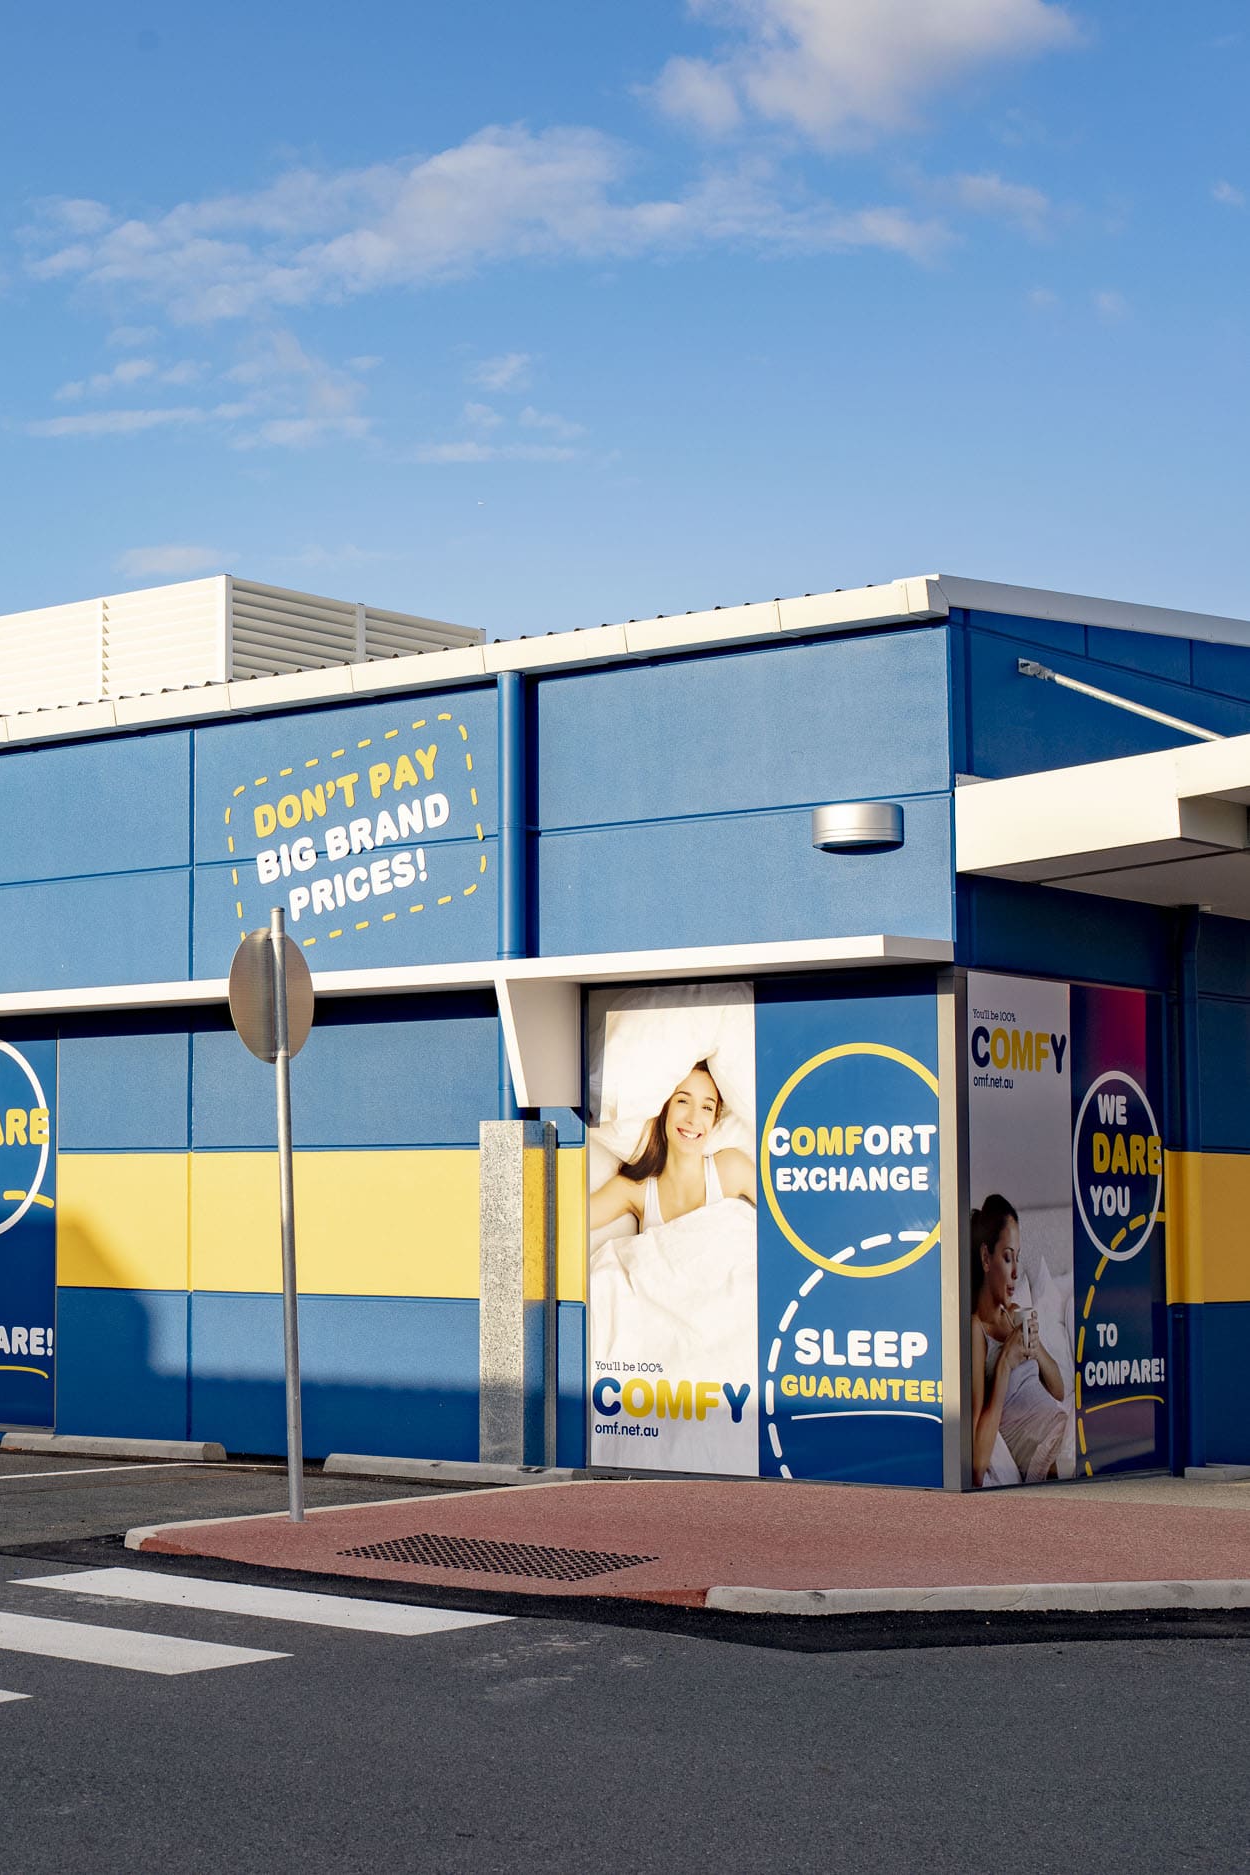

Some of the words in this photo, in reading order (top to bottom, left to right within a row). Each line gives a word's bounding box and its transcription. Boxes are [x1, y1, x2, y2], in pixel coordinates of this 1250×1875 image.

[253, 772, 359, 838] DON'T
[368, 744, 438, 798] PAY
[256, 837, 317, 884] BIG
[324, 793, 450, 861] BRAND
[289, 847, 428, 922] PRICES!
[972, 1009, 989, 1019] You'll
[990, 1010, 999, 1020] be
[999, 1011, 1016, 1022] 100%
[971, 1026, 1067, 1074] COMFY
[973, 1074, 1014, 1089] omf.net.au
[1097, 1093, 1127, 1126] WE
[767, 1124, 937, 1157] COMFORT
[1092, 1132, 1162, 1176] DARE
[776, 1166, 929, 1192] EXCHANGE
[1090, 1185, 1131, 1217] YOU
[794, 1328, 928, 1369] SLEEP
[1096, 1322, 1118, 1348] TO
[595, 1361, 621, 1371] You'll
[623, 1362, 636, 1372] be
[637, 1362, 663, 1373] 100%
[1084, 1358, 1165, 1387] COMPARE!
[592, 1377, 751, 1424] COMFY
[780, 1374, 943, 1403] GUARANTEE!
[595, 1421, 659, 1438] omf.net.au
